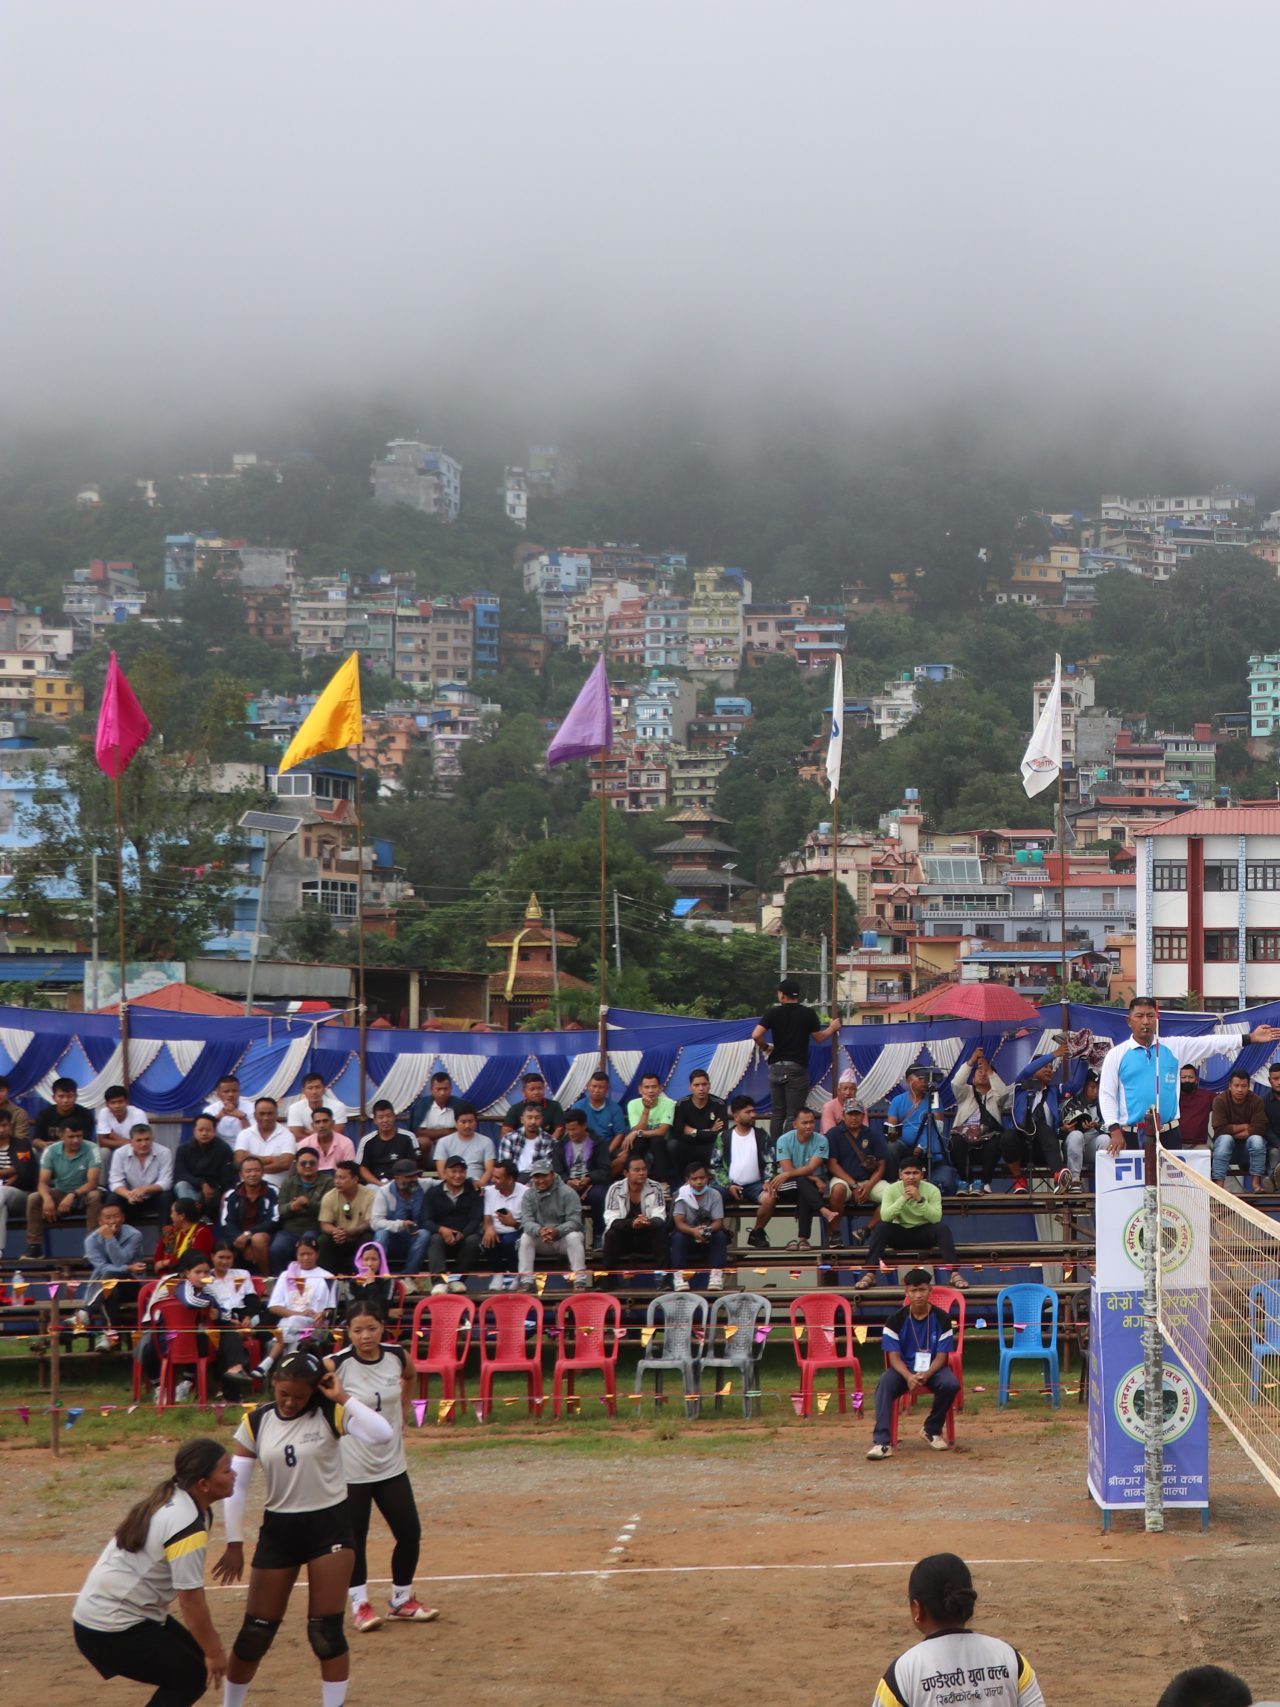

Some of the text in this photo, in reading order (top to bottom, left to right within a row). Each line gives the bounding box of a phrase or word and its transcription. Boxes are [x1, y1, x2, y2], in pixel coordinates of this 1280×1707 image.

[284, 1444, 297, 1467] 8
[1107, 1475, 1141, 1487] श्रीनगर
[967, 1667, 985, 1687] युवा
[987, 1665, 1009, 1680] क्लब
